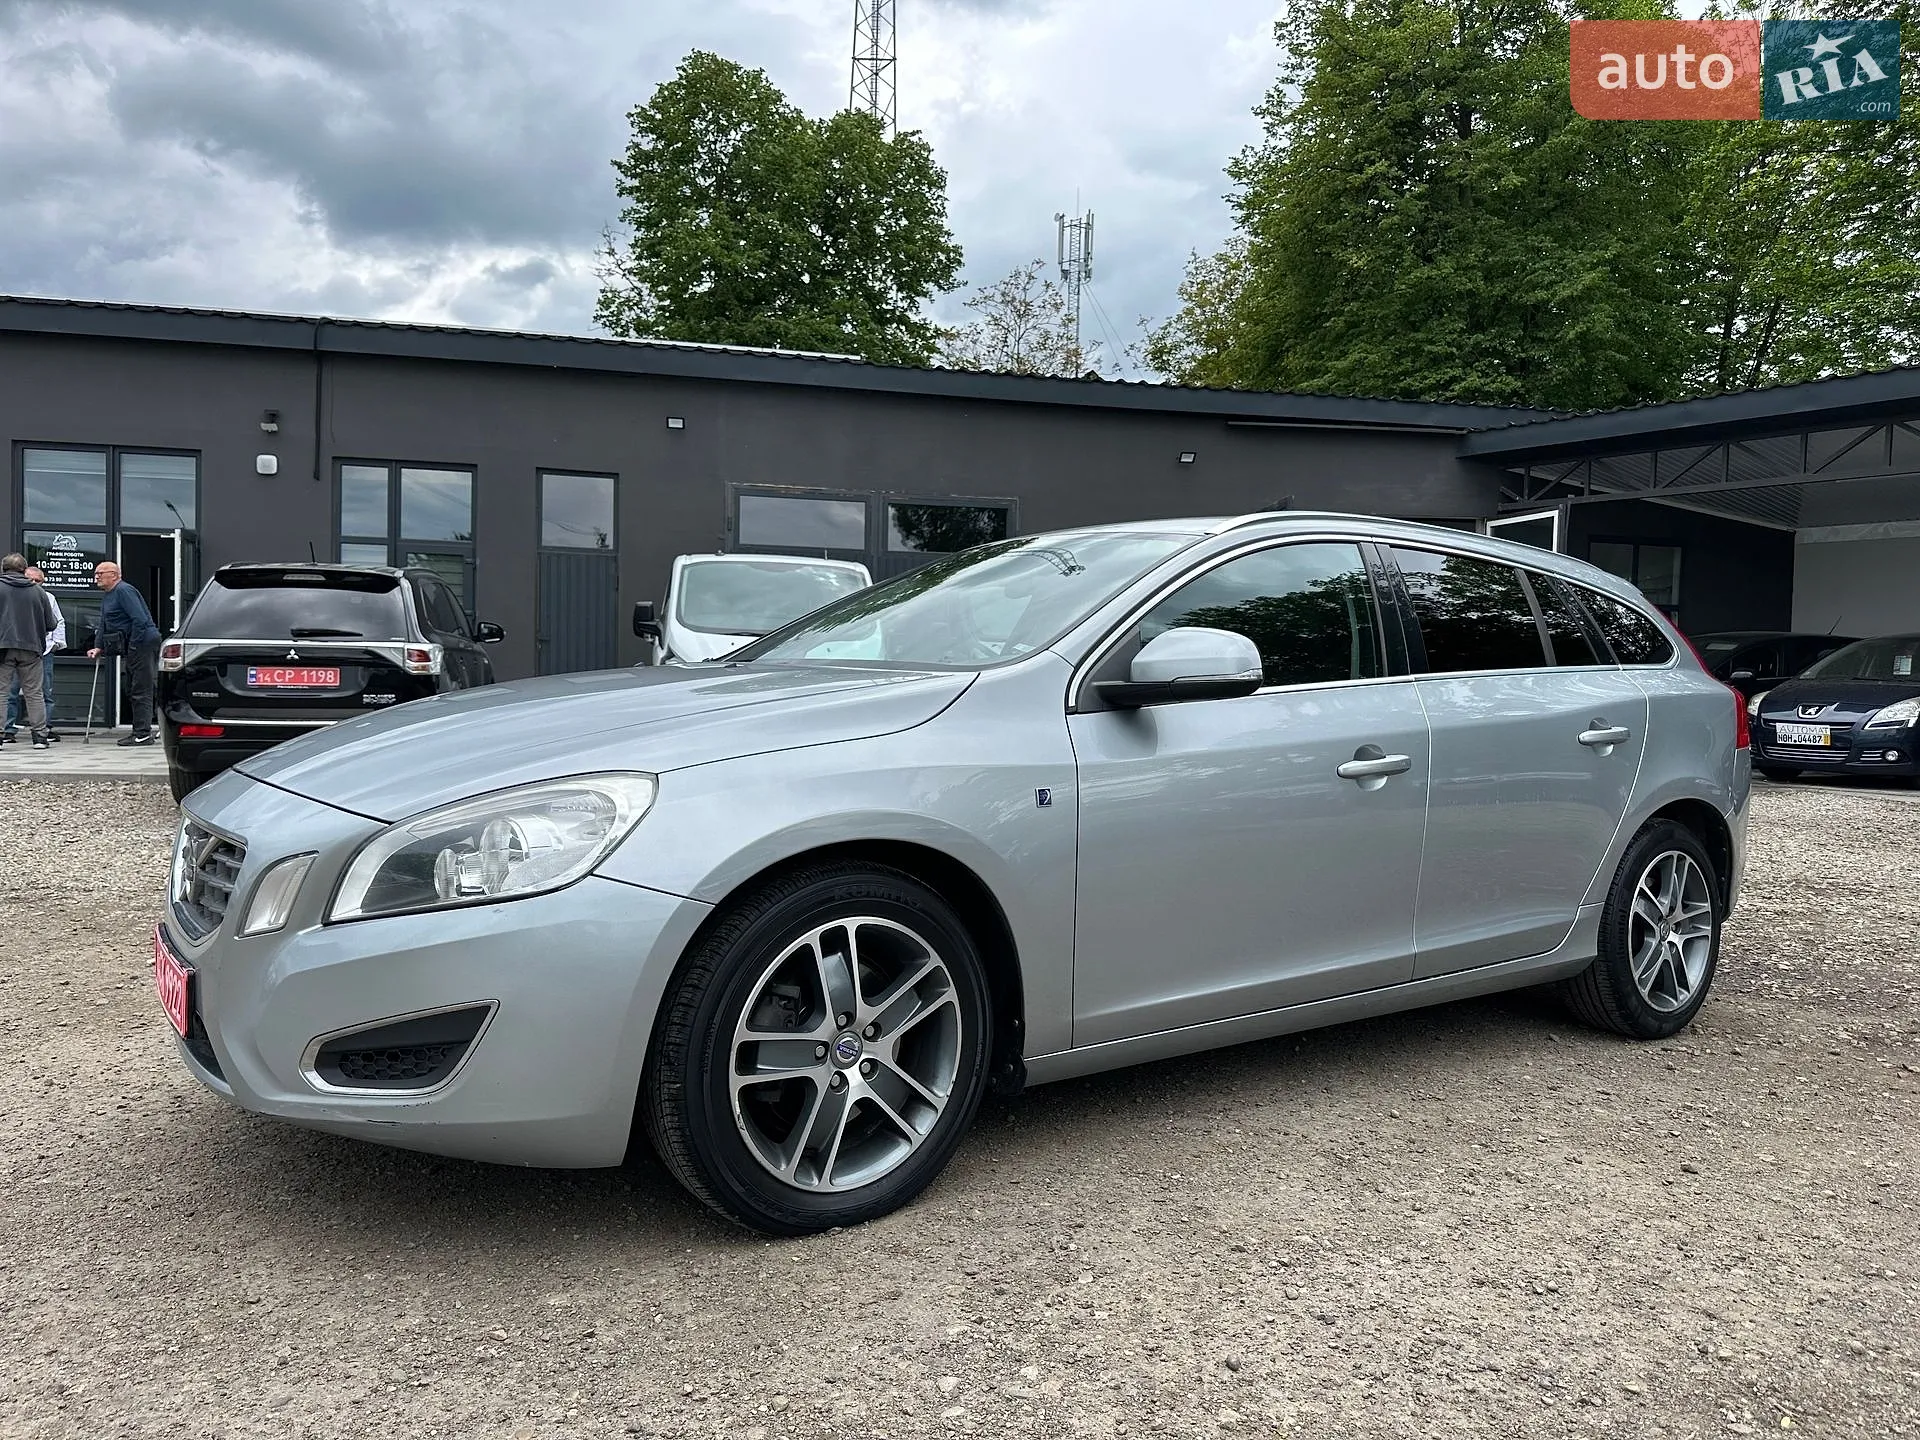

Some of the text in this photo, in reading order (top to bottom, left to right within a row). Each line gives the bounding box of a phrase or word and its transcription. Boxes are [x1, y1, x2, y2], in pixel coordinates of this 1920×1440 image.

[36, 560, 61, 569] 10:00
[69, 561, 93, 570] 18:00
[257, 673, 271, 683] 14
[273, 670, 295, 682] CP
[300, 670, 335, 683] 1198
[1780, 725, 1829, 734] AUTOMAT
